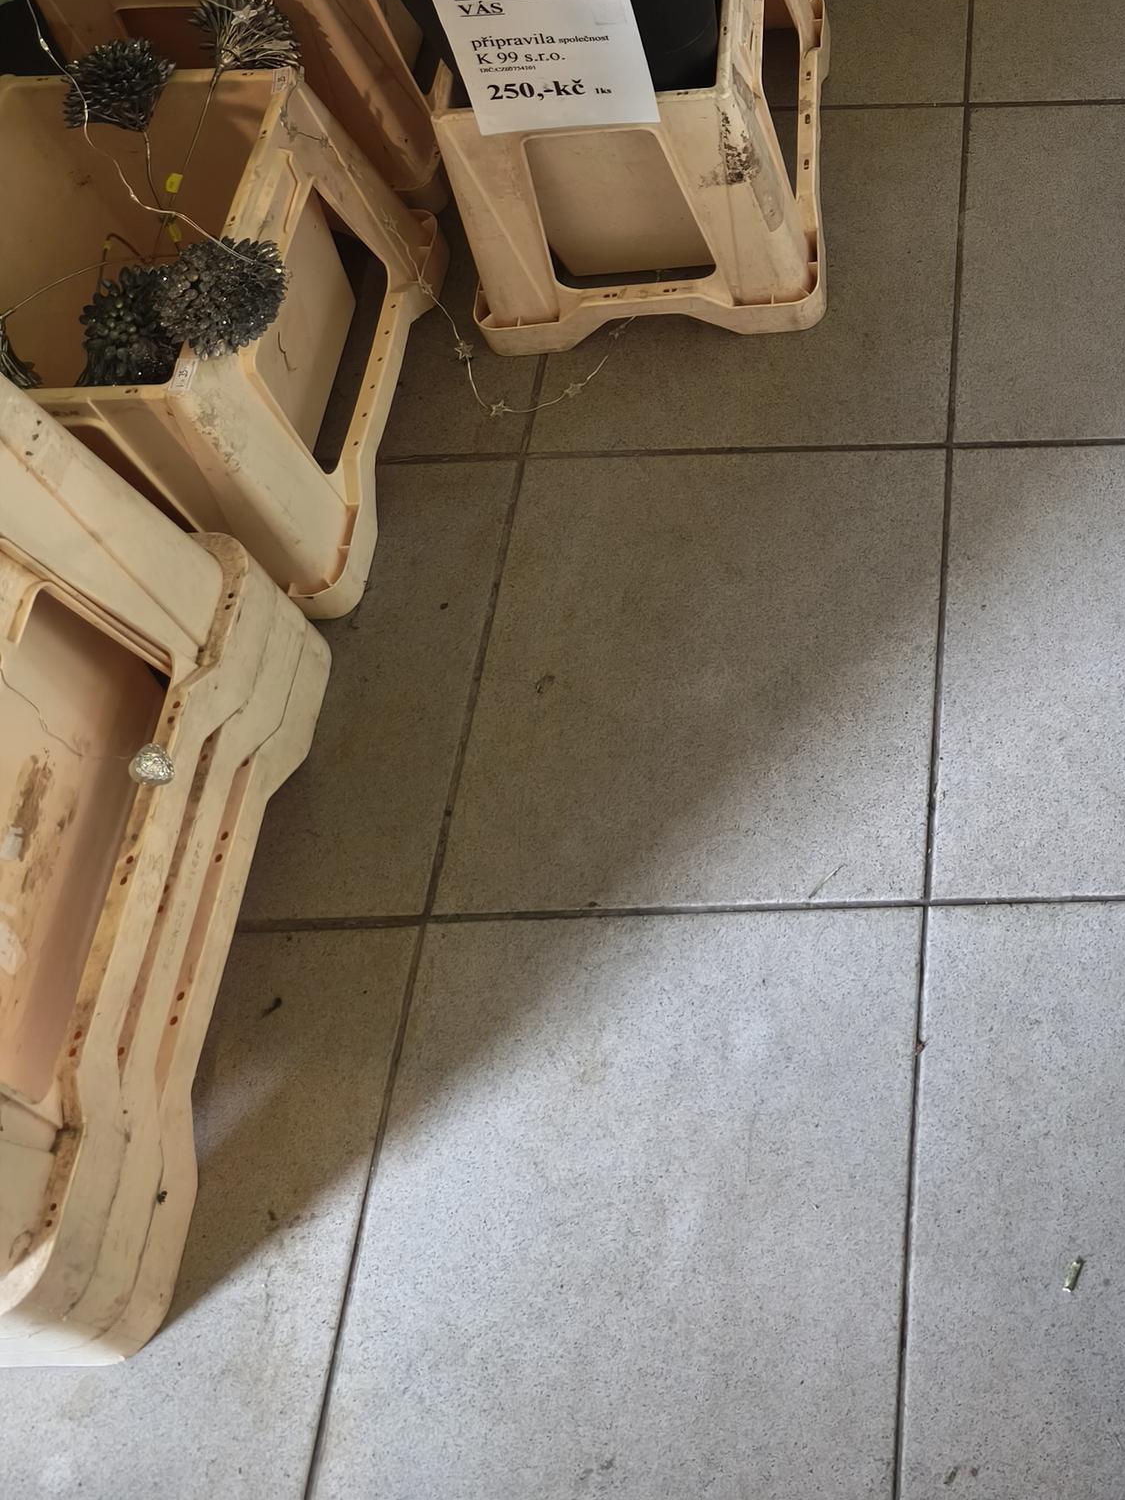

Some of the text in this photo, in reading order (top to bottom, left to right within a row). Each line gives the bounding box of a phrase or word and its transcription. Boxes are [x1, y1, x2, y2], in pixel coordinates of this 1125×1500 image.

[458, 2, 505, 16] VÁS
[471, 33, 611, 52] připravila společnost
[477, 51, 566, 65] K 99 s.r.o.
[487, 78, 587, 102] 250,-kč
